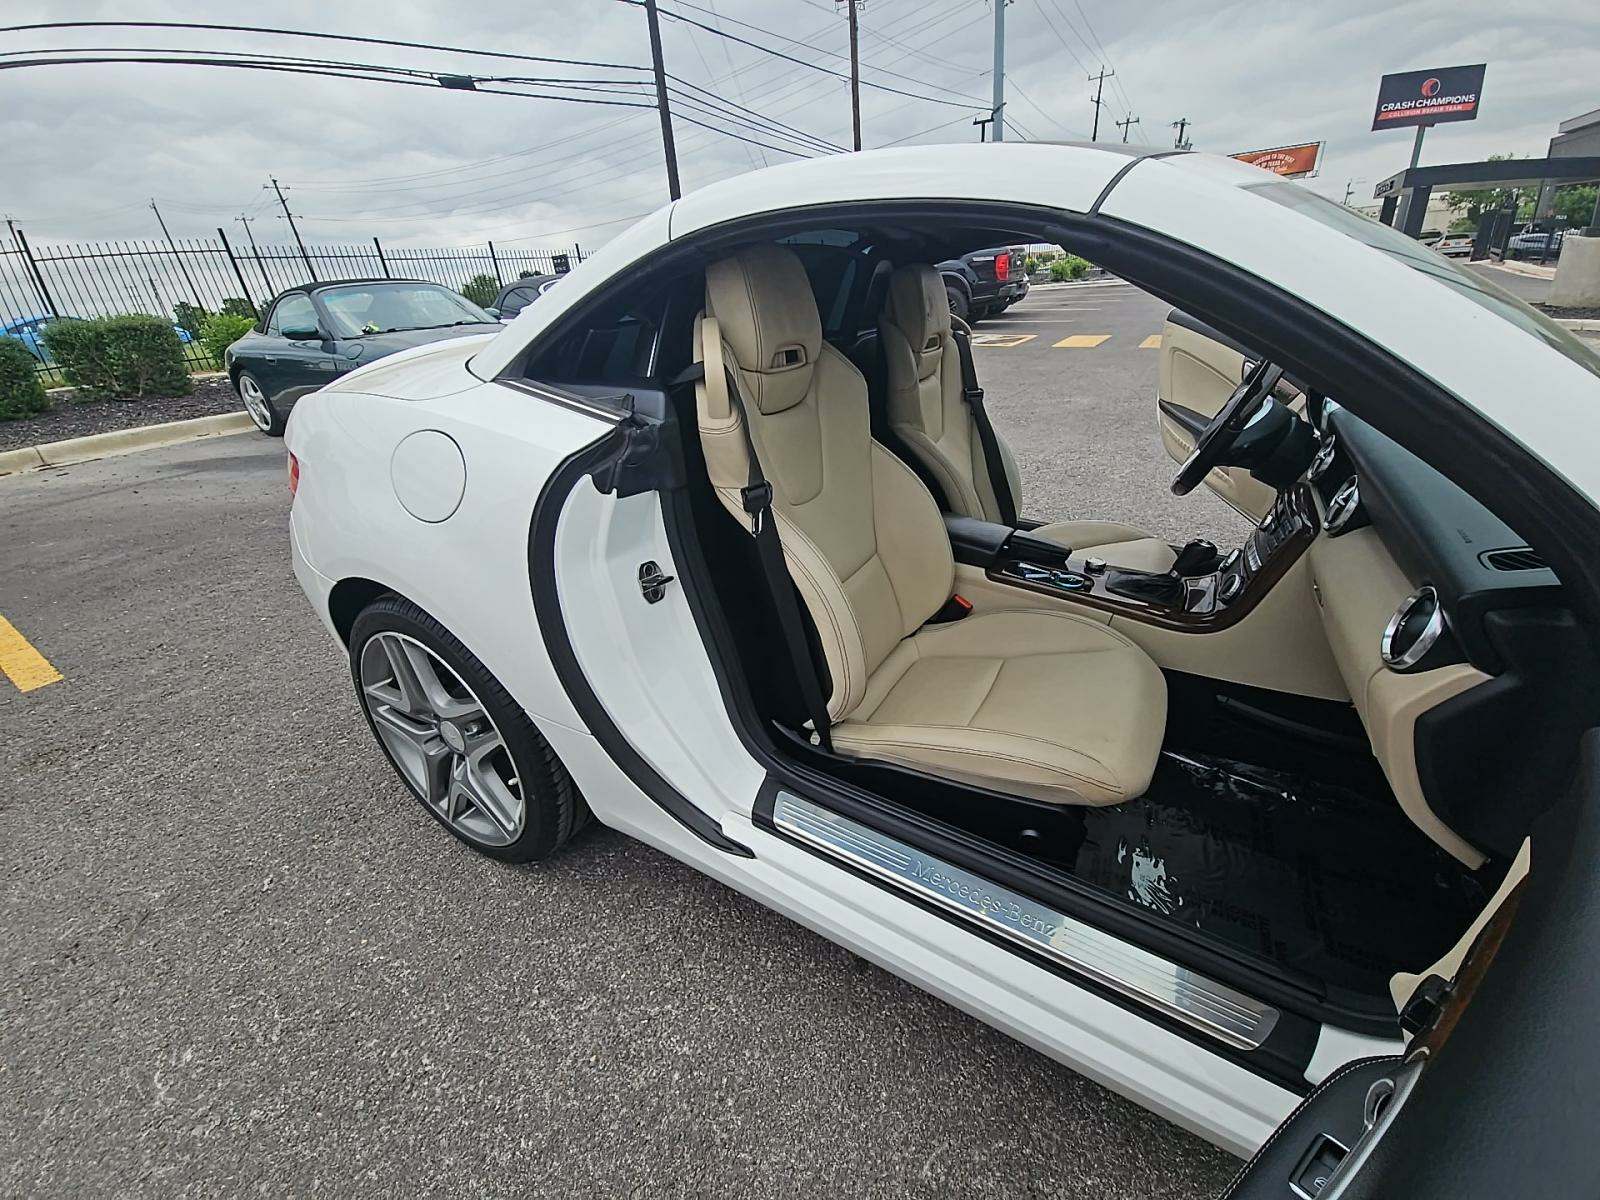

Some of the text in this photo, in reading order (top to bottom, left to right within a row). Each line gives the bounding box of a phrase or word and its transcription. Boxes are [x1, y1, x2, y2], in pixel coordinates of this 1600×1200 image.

[1381, 94, 1476, 112] CRASH CHAMPIONS
[1388, 104, 1463, 118] COLLISION REPAIR TEAM
[911, 860, 1058, 937] Mercedes-Benz
